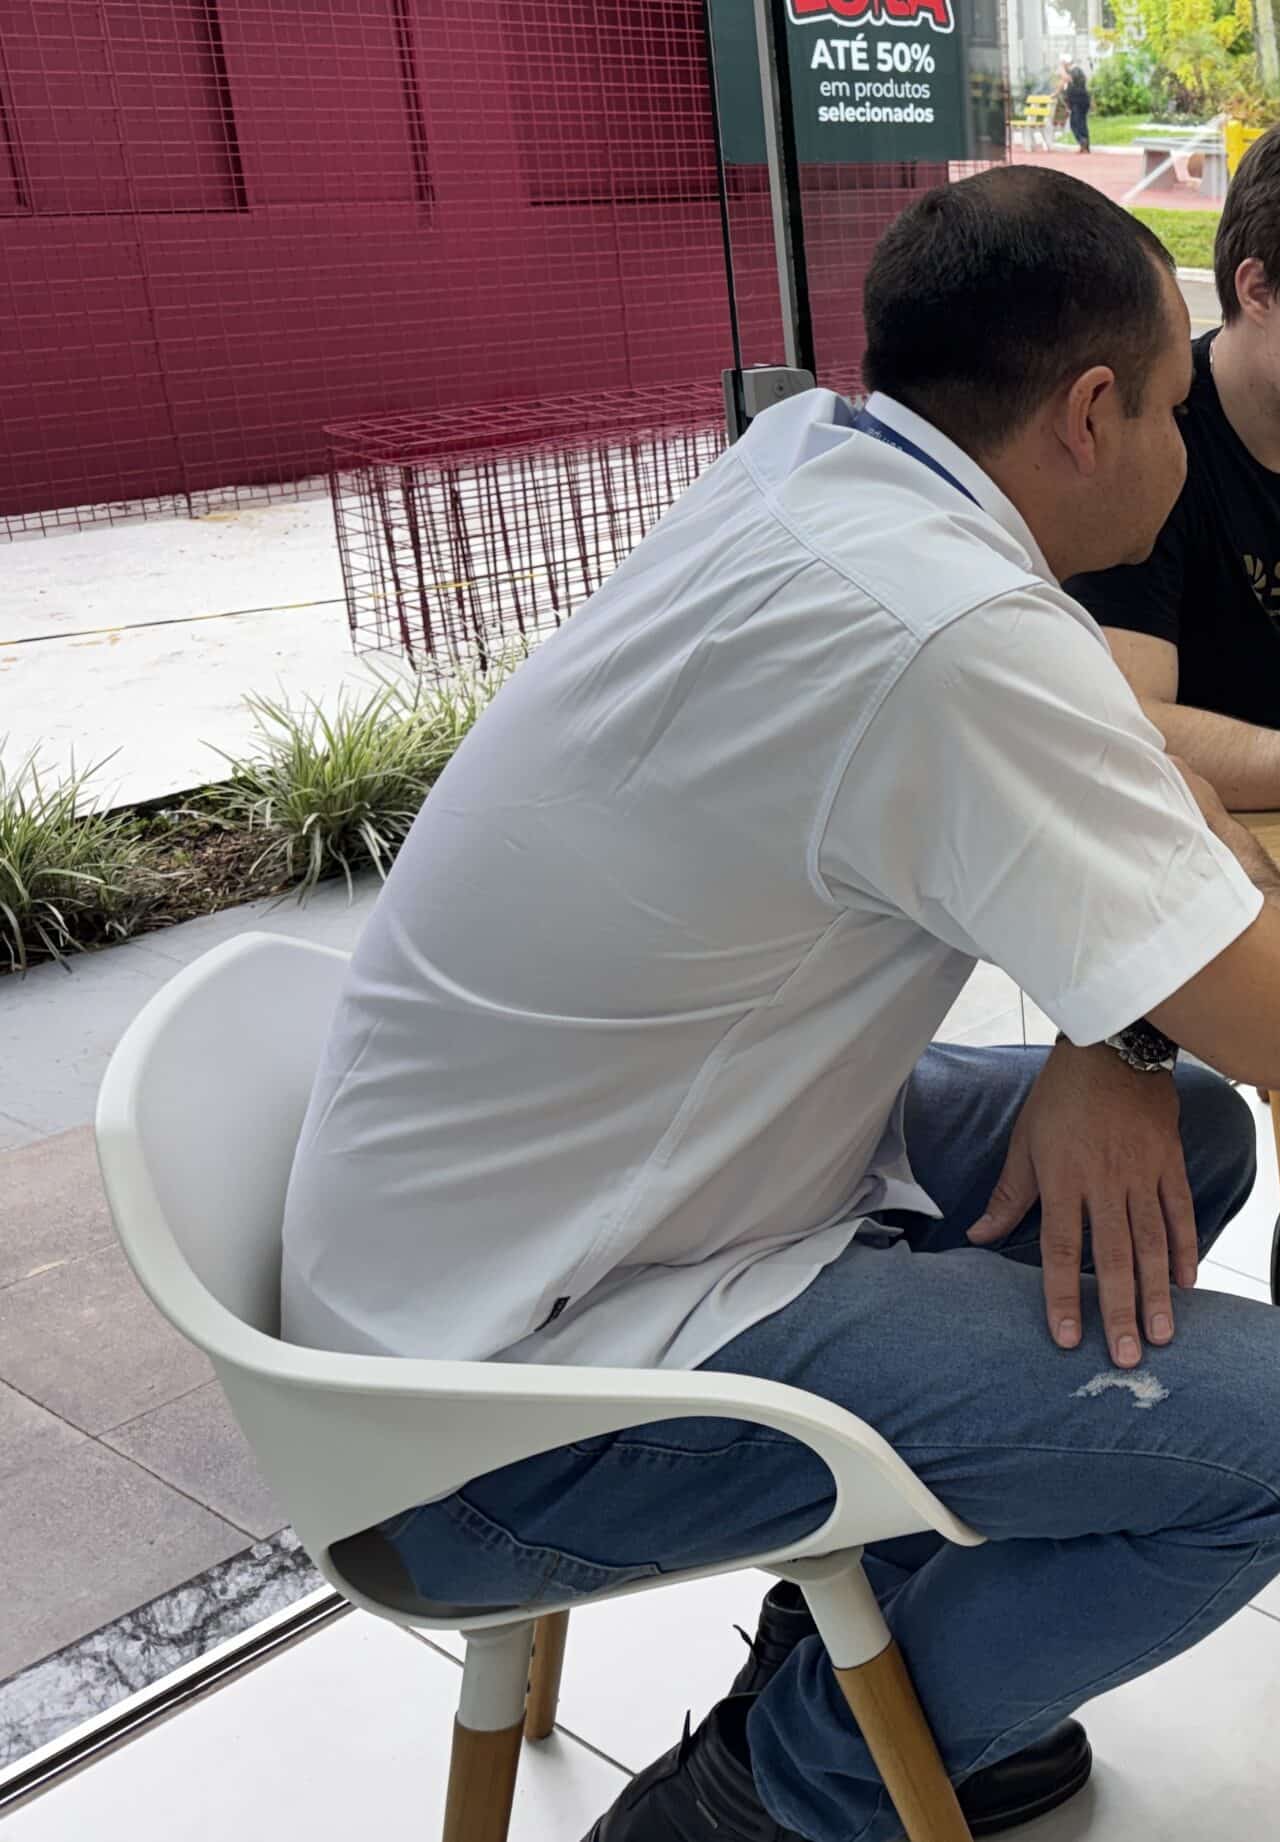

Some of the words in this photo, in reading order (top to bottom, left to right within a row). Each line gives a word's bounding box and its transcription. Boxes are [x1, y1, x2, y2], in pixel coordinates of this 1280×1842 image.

[810, 33, 870, 71] ATÉ
[876, 41, 936, 74] 50%
[819, 81, 850, 97] em
[854, 78, 931, 100] produtos
[817, 102, 935, 123] selecionados
